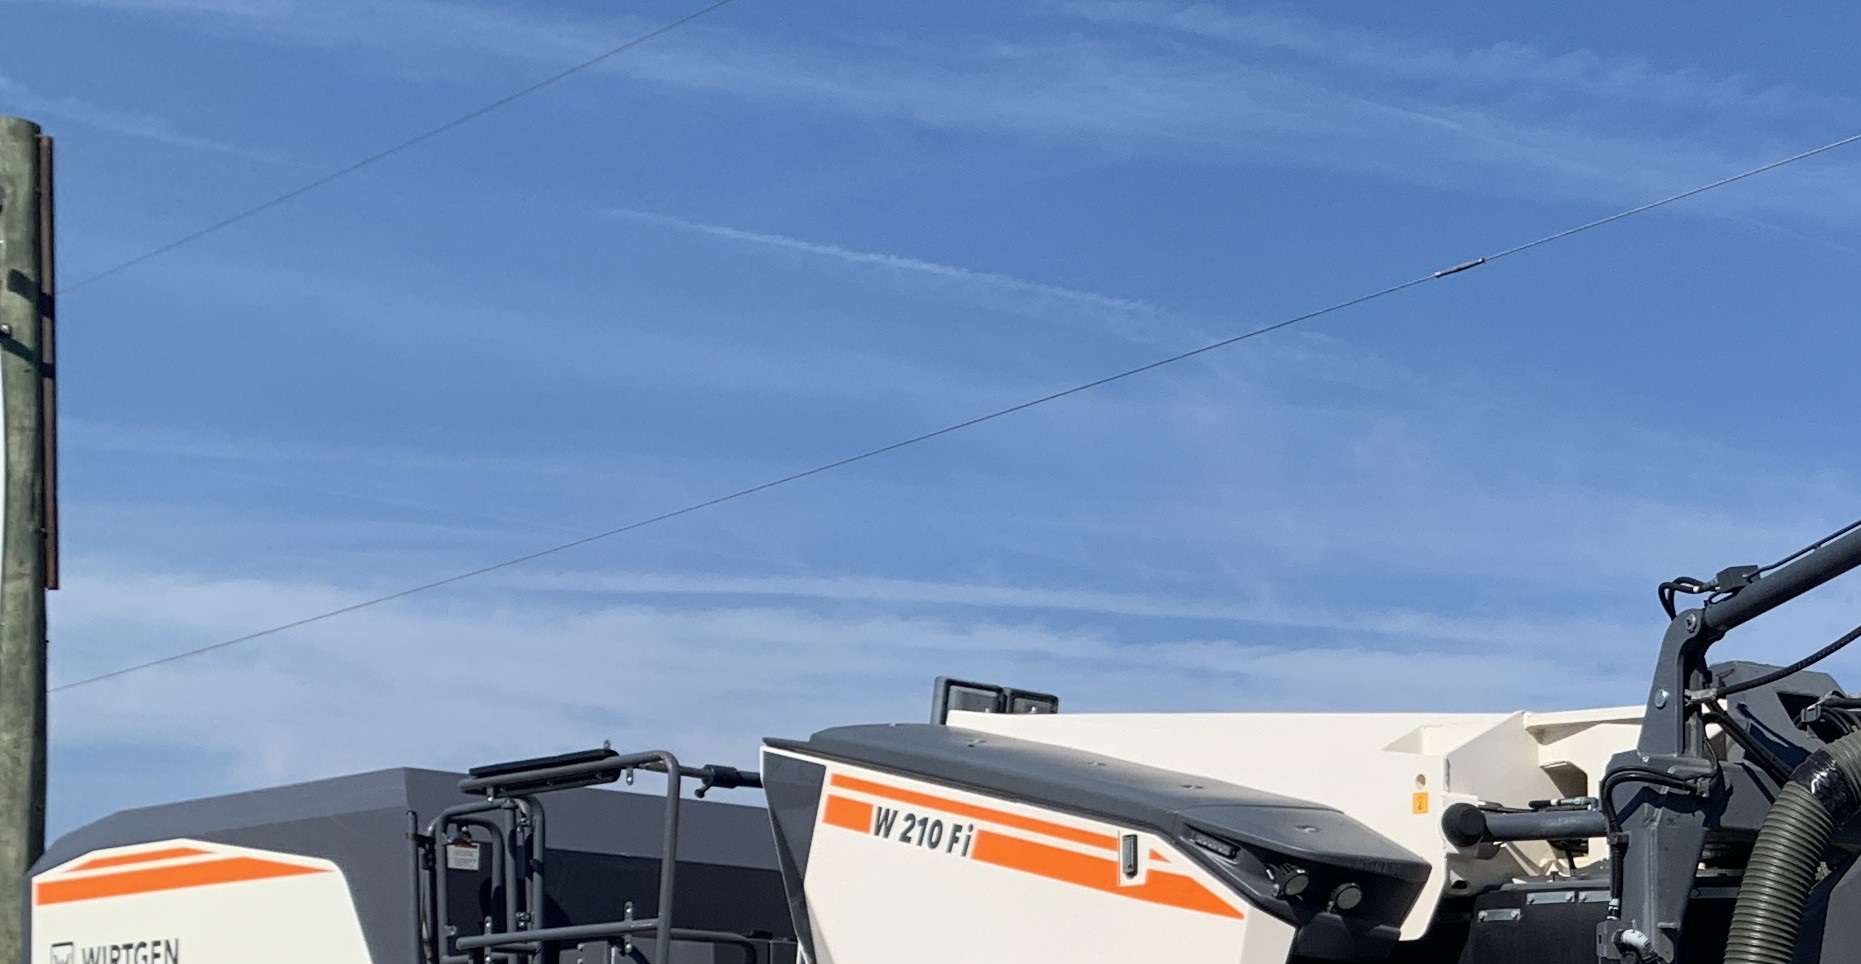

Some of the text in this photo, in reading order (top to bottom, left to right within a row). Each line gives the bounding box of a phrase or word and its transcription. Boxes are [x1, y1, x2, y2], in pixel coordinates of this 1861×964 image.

[874, 806, 974, 857] W 210 Fi
